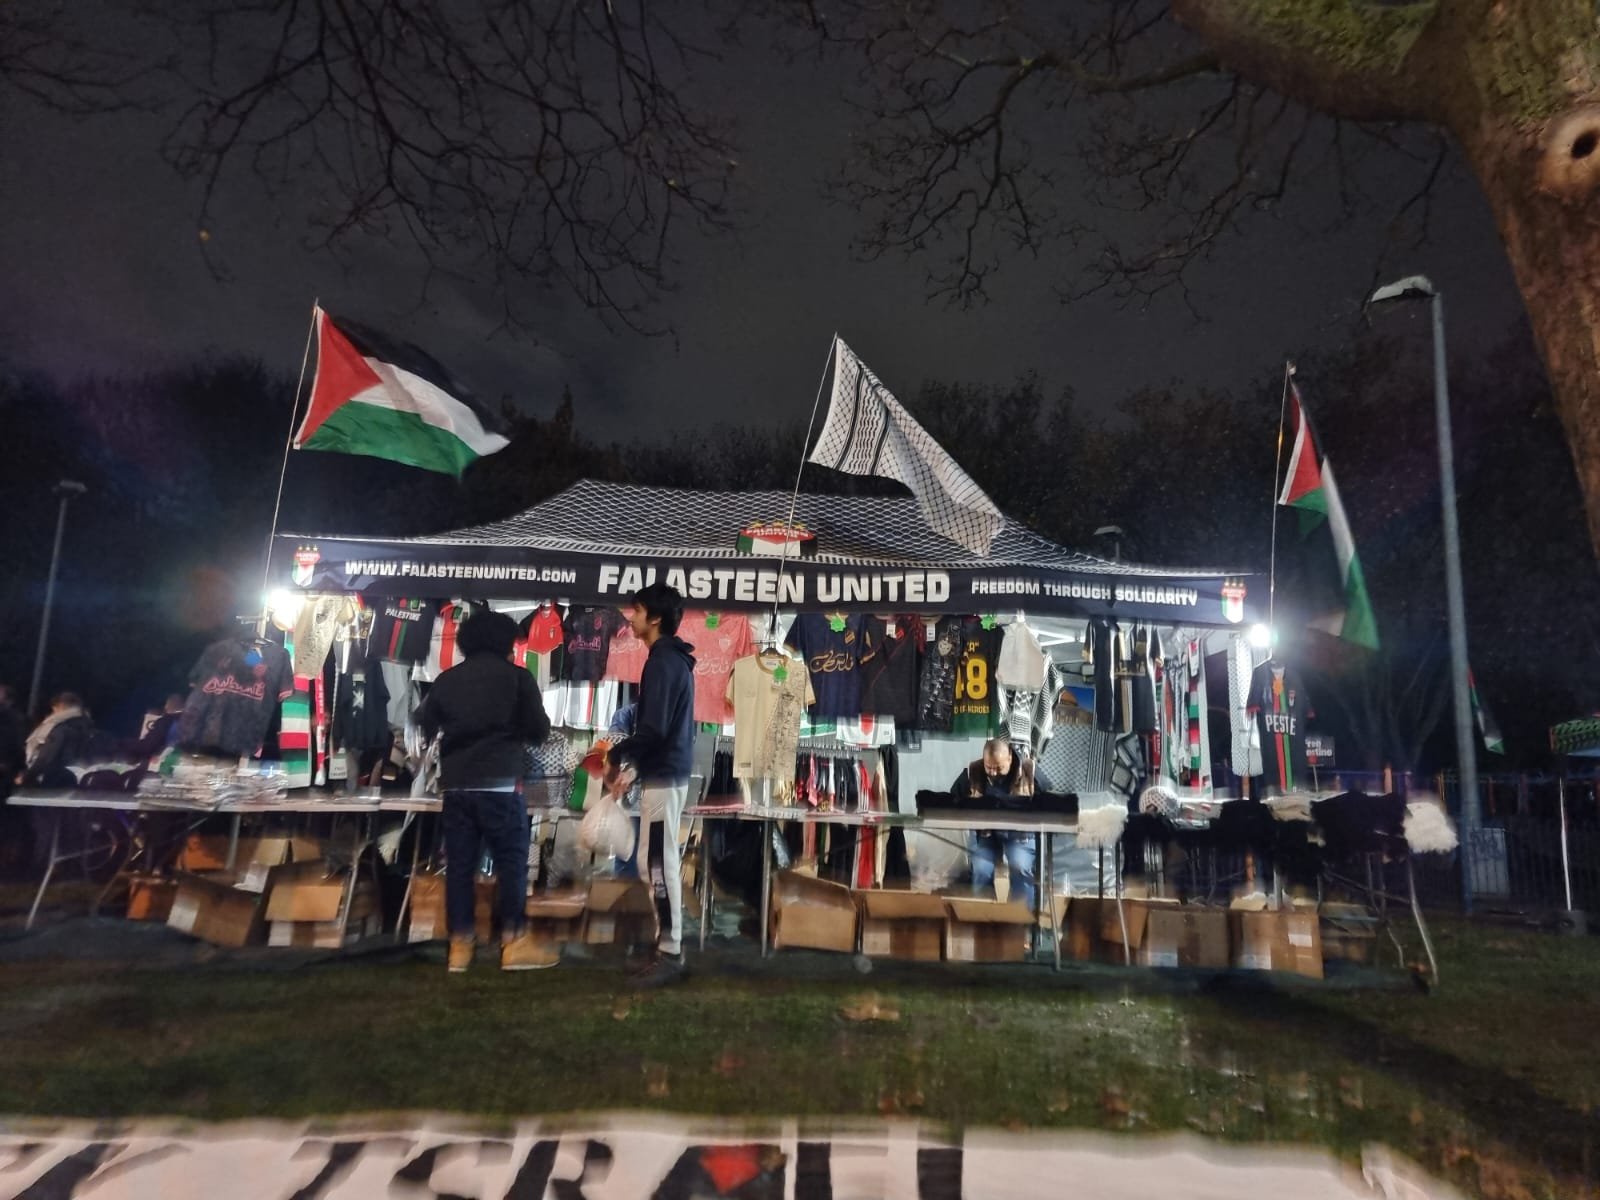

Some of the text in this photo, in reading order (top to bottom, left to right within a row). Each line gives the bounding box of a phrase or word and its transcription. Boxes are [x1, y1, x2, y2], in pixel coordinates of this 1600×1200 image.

[345, 560, 577, 584] WWW.FALASTEENUNITED.COM
[816, 570, 951, 604] UNITED
[971, 579, 1199, 607] FREEDOM THROUGH SOLIDARITY
